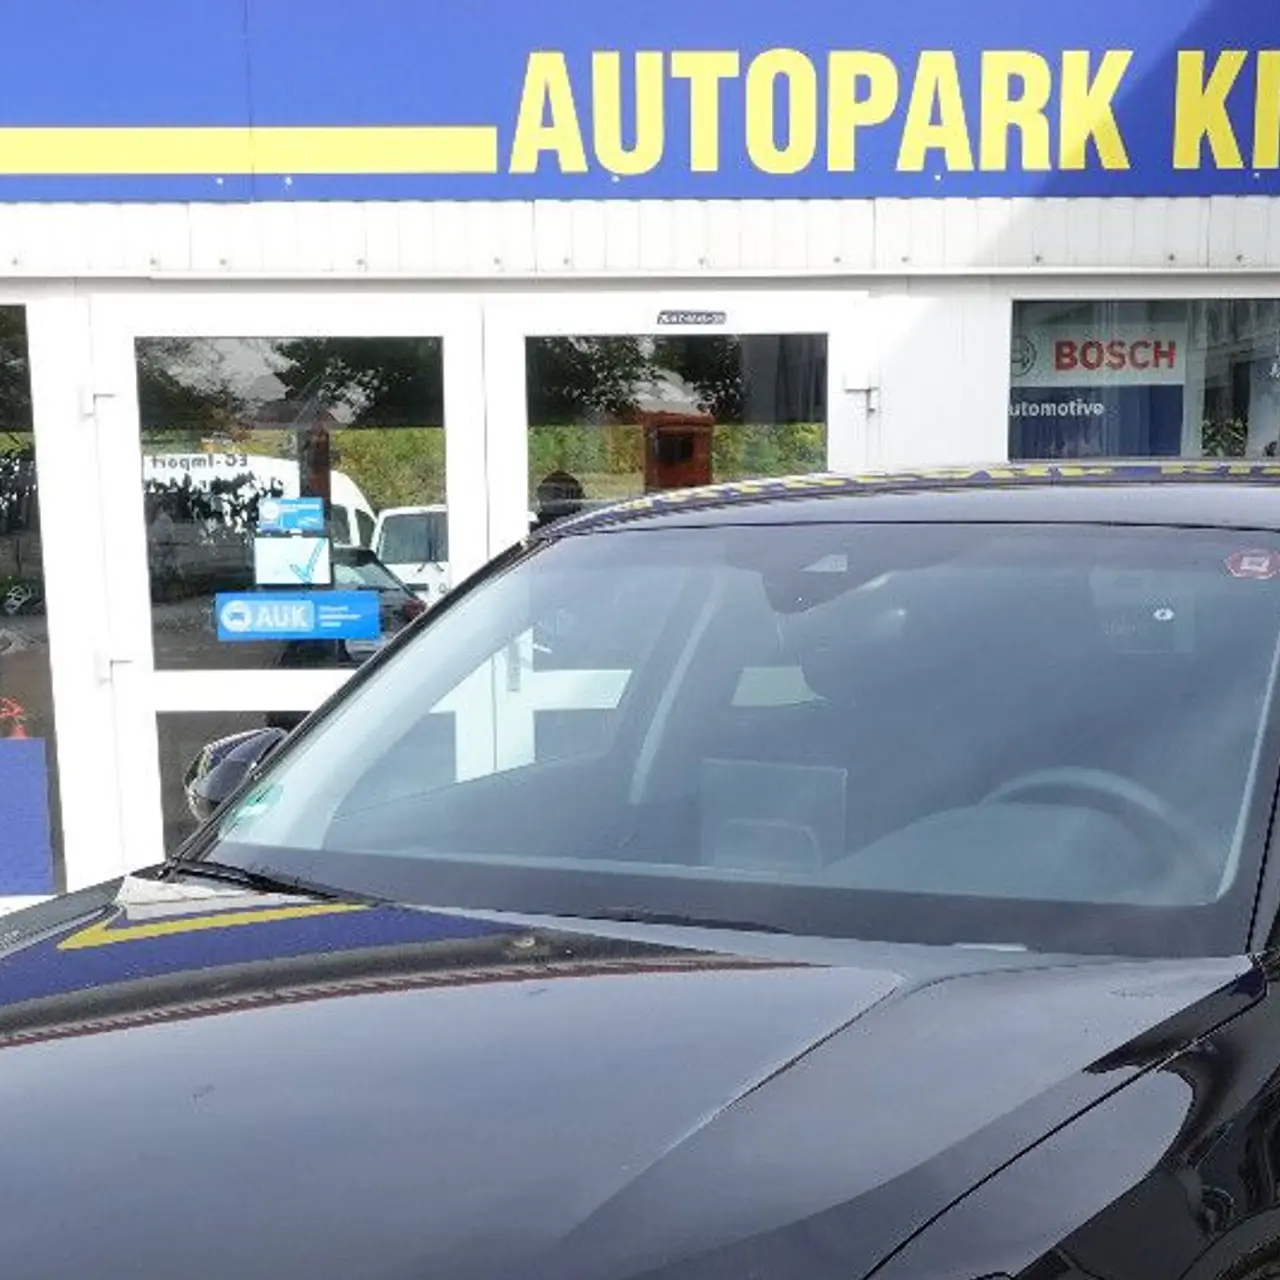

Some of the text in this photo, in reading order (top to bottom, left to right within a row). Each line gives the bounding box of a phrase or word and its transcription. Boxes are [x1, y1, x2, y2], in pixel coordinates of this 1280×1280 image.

[508, 47, 1134, 176] AUTOPARK
[1053, 339, 1177, 372] BOSCH
[1006, 398, 1105, 417] utomotive
[255, 604, 308, 629] AUK
